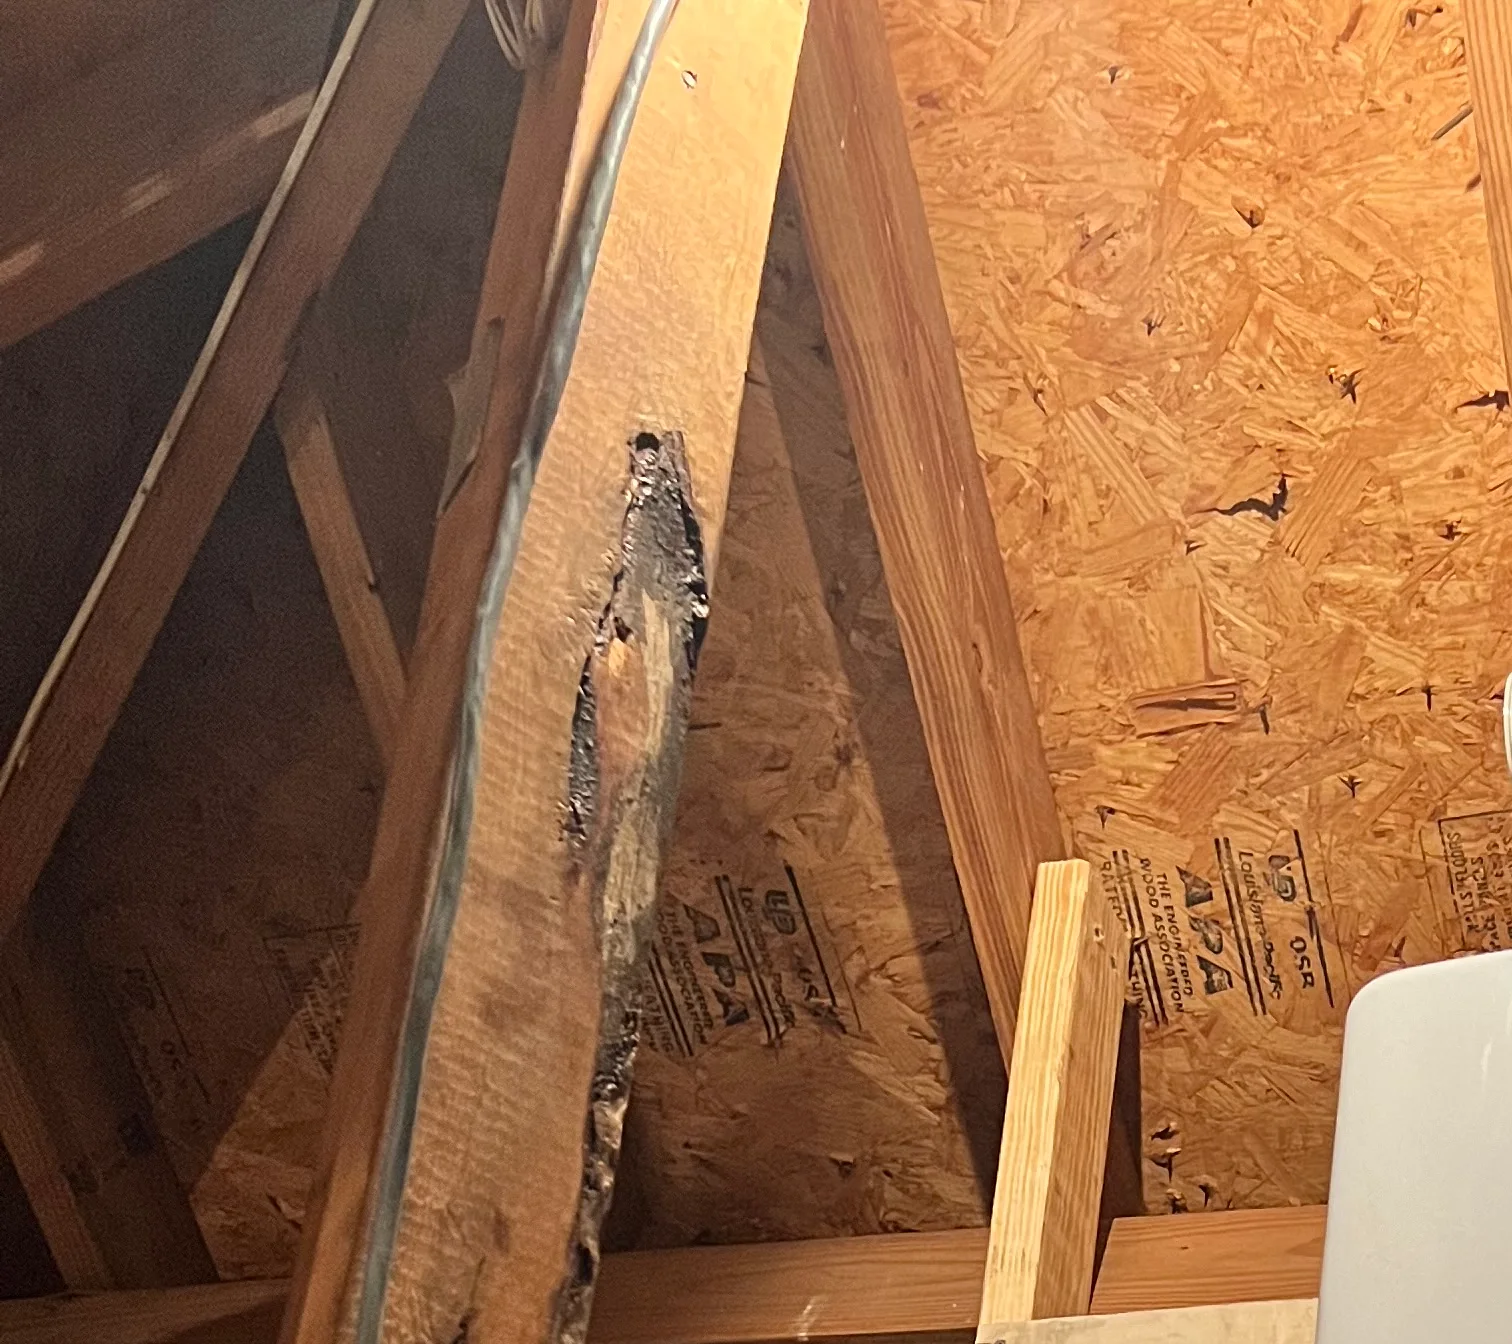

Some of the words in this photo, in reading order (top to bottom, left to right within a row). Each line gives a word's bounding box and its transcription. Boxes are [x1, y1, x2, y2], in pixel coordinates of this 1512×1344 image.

[1140, 857, 1160, 909] WOOD
[1151, 912, 1185, 1014] ASSOCIATION
[1155, 872, 1172, 901] THE
[1175, 865, 1235, 996] APA
[682, 903, 750, 1027] APA
